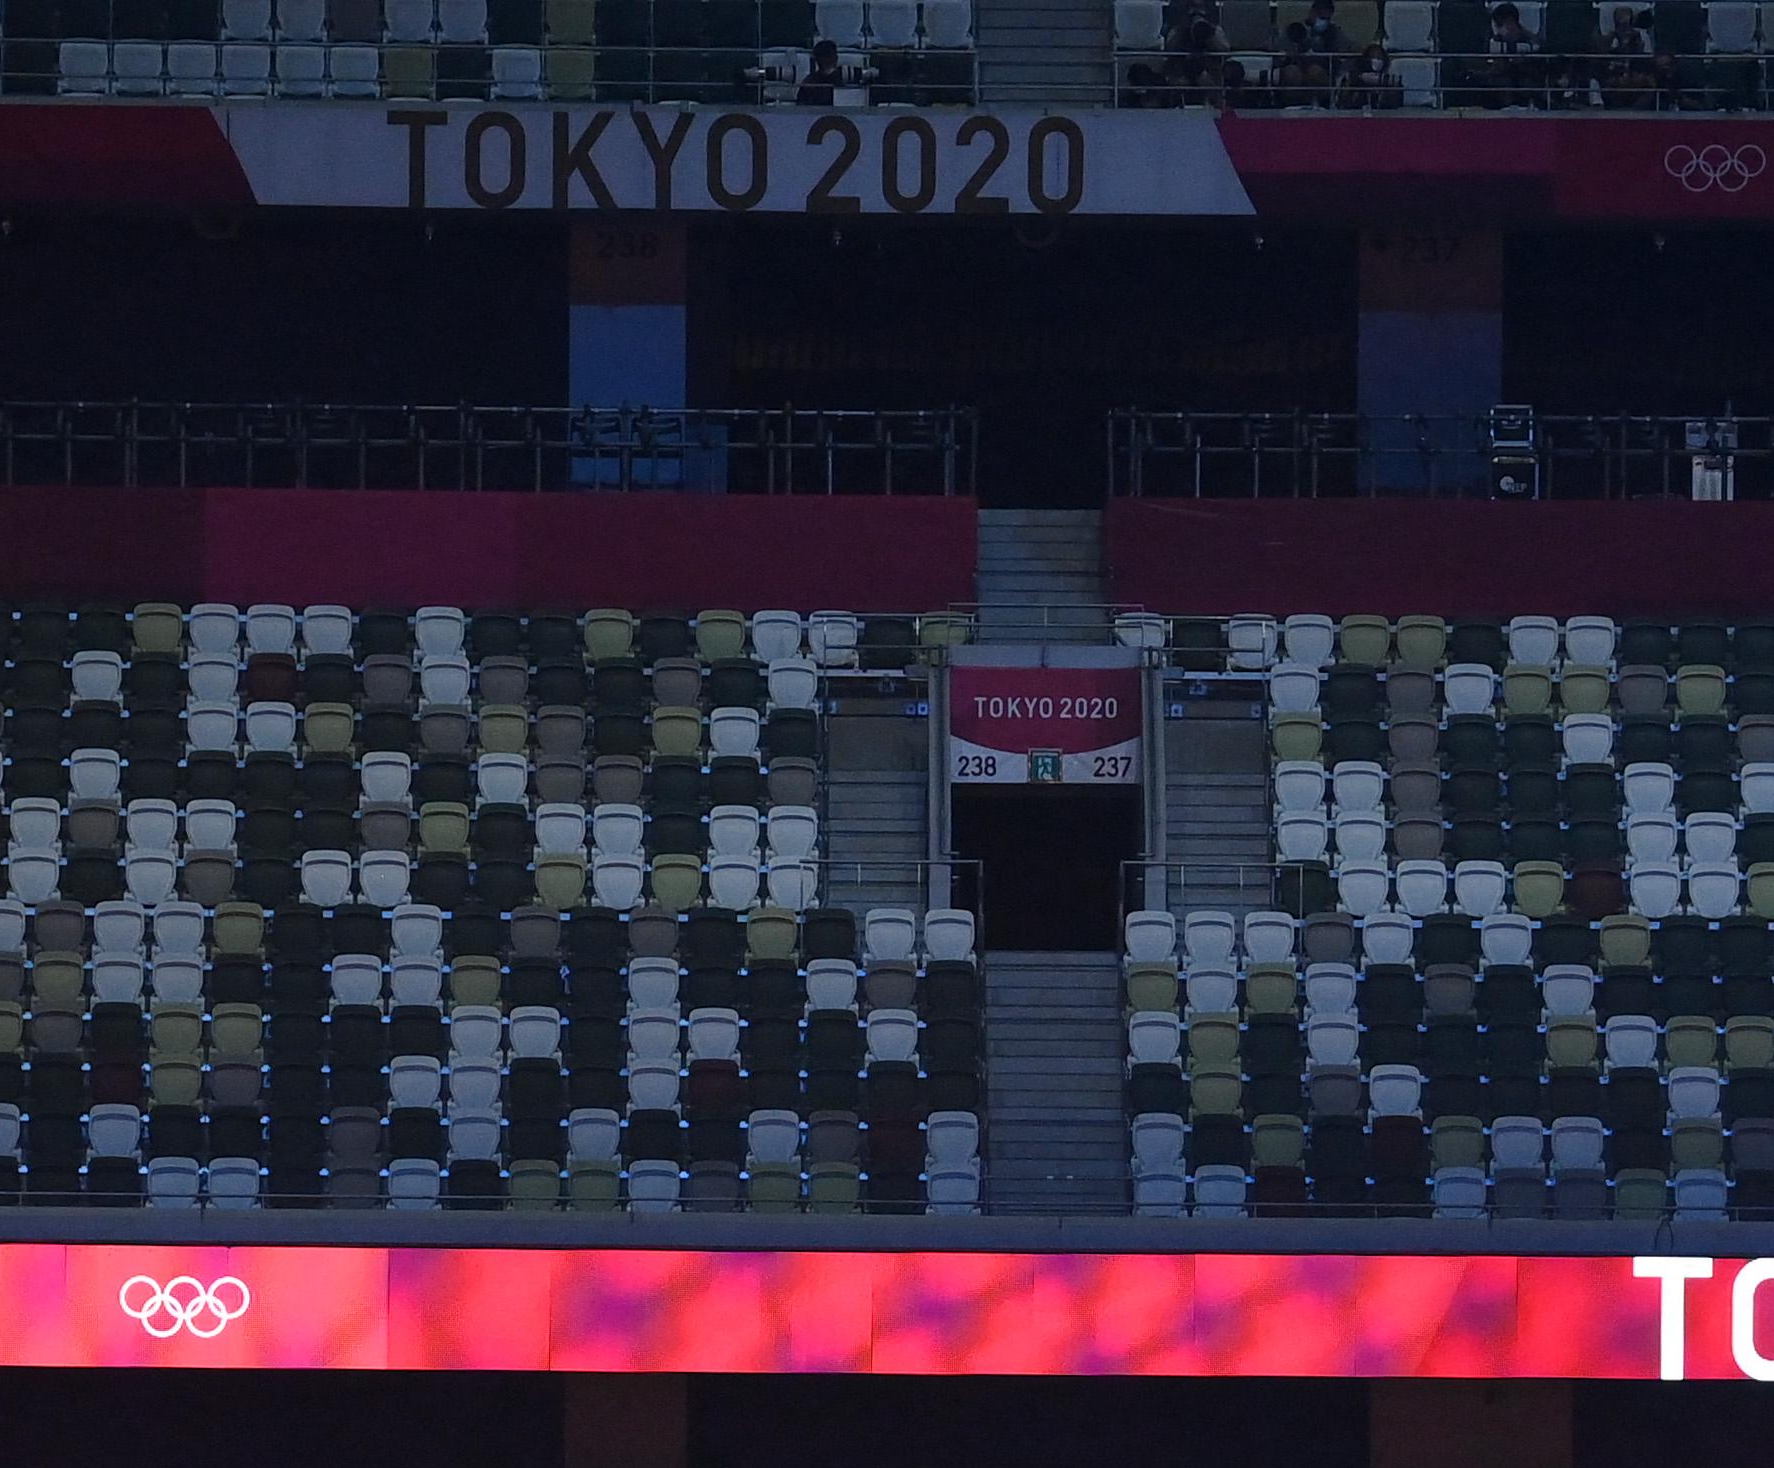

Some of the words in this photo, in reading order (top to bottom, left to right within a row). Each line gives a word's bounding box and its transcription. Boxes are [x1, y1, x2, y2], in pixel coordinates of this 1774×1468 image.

[387, 111, 767, 210] TOKYO
[806, 116, 1084, 213] 2020
[597, 231, 658, 258] 238
[1400, 236, 1459, 263] 237
[974, 697, 1053, 718] TOKYO
[1059, 697, 1118, 718] 2020
[958, 756, 996, 777] 238
[1093, 757, 1131, 777] 237
